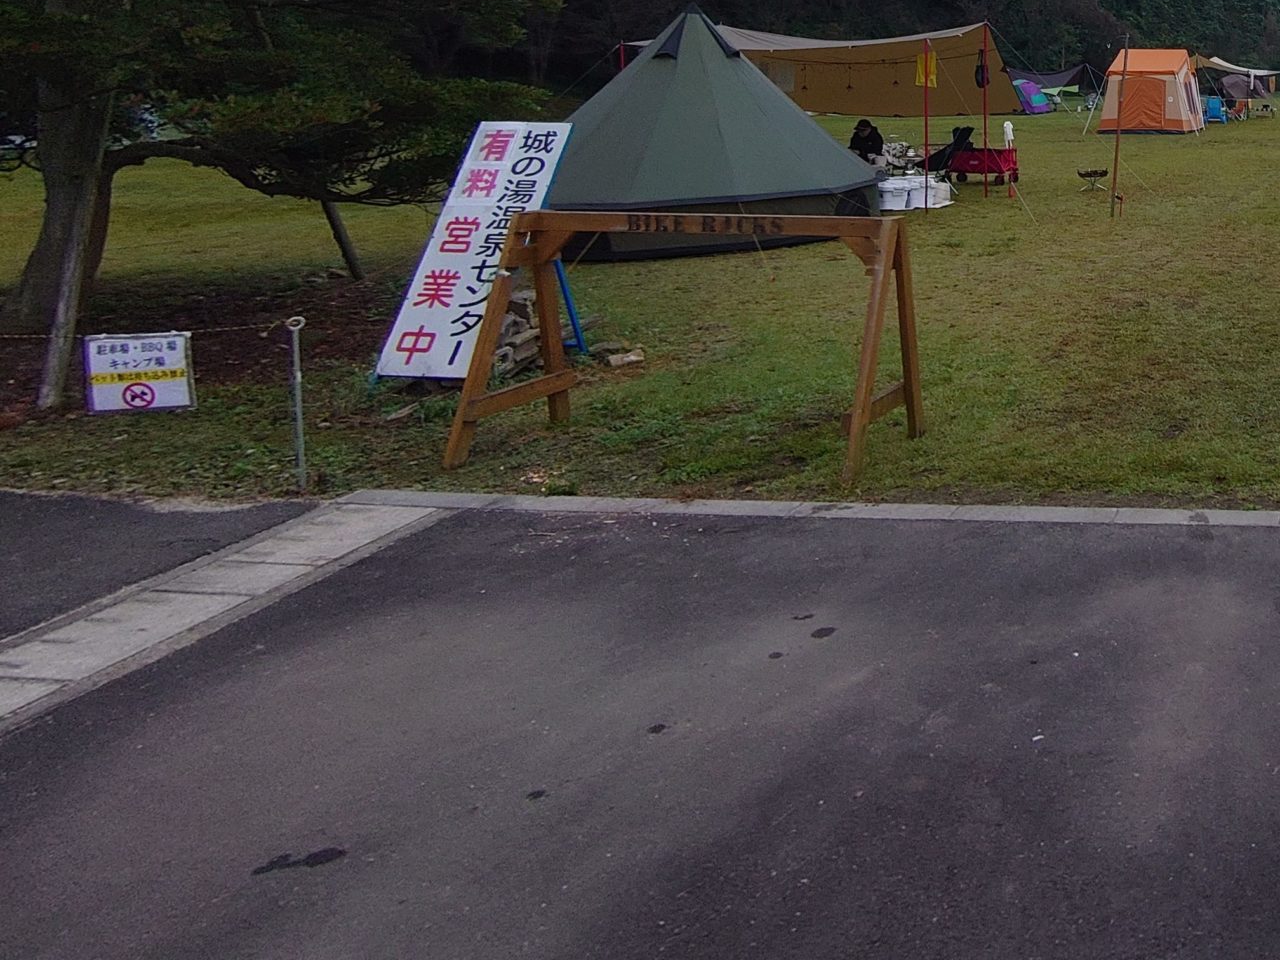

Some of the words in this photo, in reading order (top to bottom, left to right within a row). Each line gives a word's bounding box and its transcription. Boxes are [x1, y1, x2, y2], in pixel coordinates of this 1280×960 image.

[109, 356, 166, 370] キャンプ場
[395, 129, 516, 366] 有料営業中
[447, 129, 558, 366] 城の湯温泉センター
